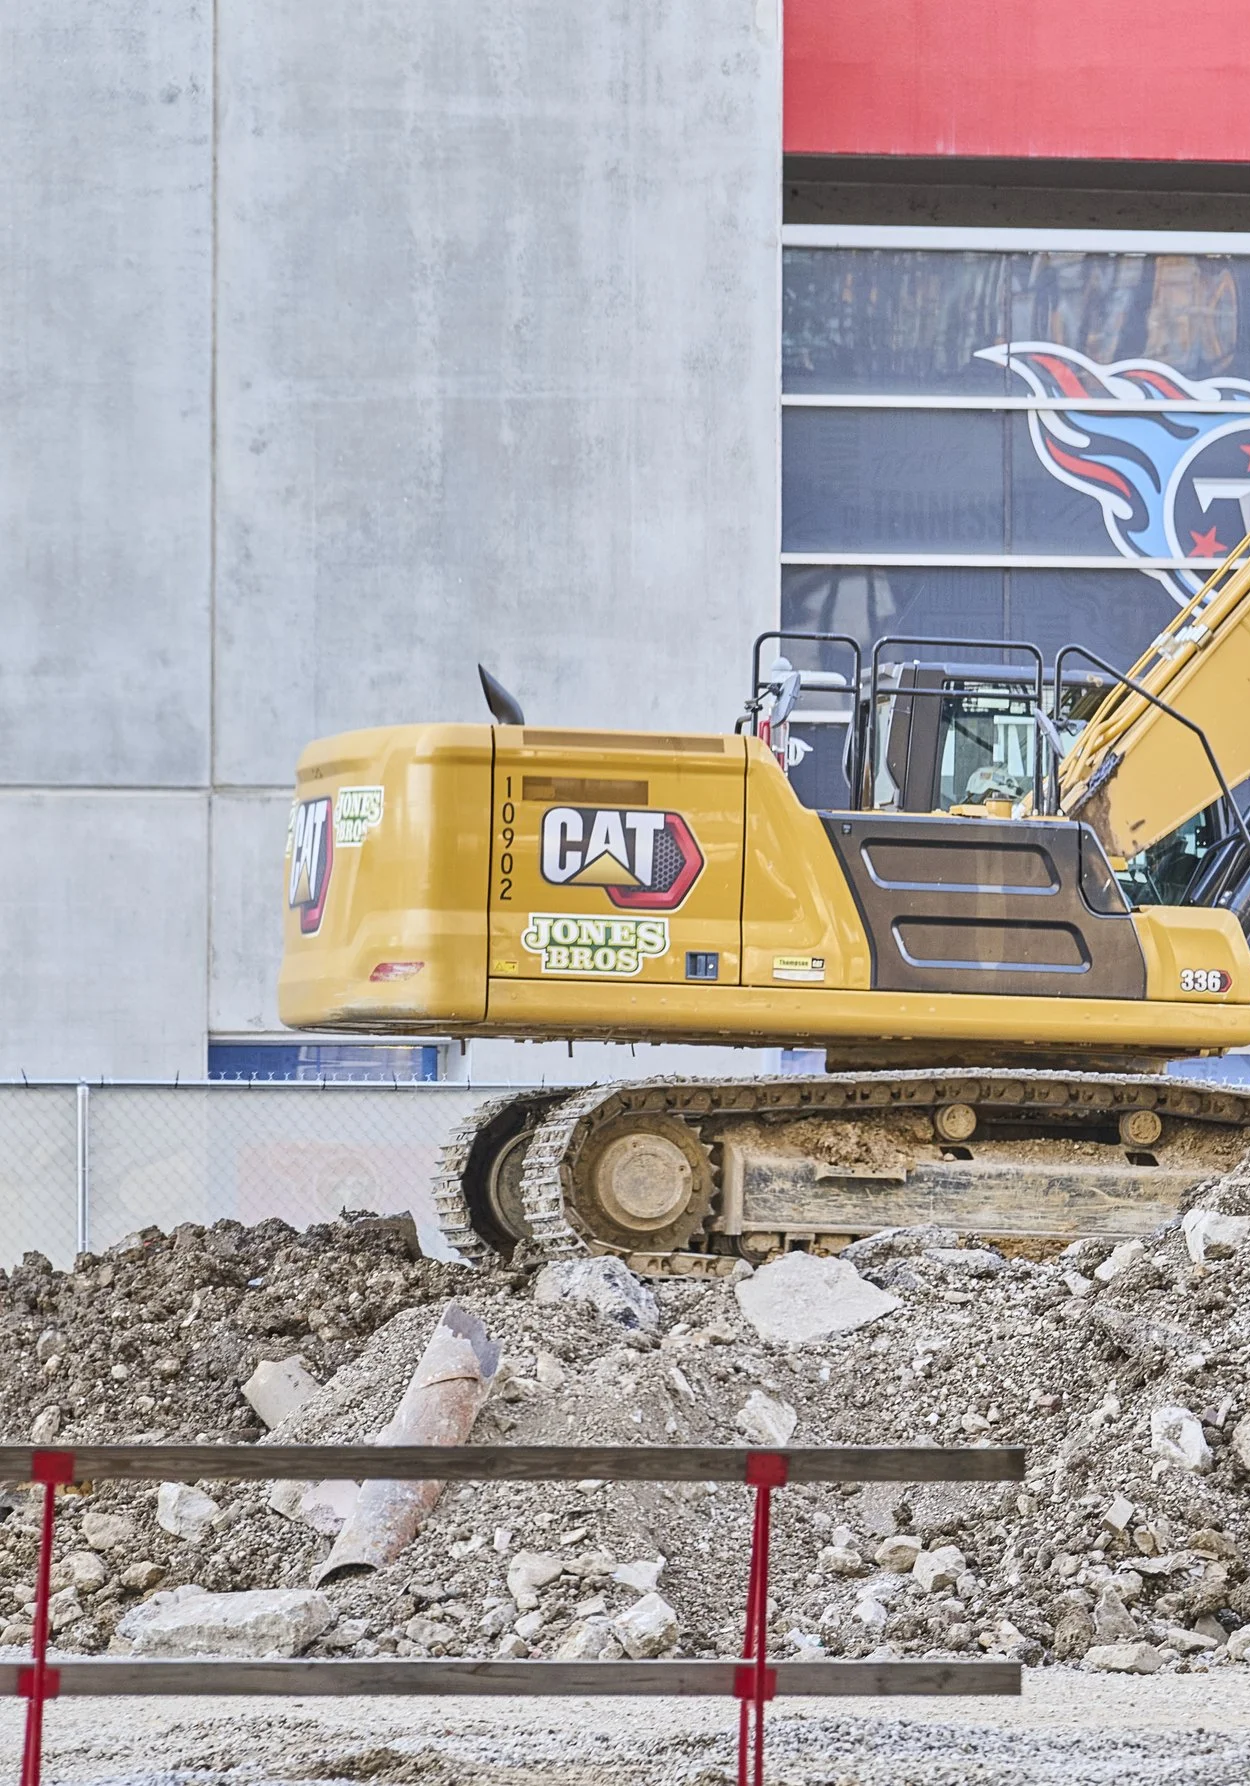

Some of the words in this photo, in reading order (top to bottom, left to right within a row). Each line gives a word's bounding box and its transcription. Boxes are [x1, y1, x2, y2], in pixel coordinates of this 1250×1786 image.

[335, 790, 382, 822] JONES
[289, 799, 328, 905] CAT
[500, 776, 515, 900] 10902
[543, 807, 665, 886] CAT
[524, 917, 667, 954] JONES
[545, 946, 639, 971] BROS
[1180, 969, 1221, 992] 336
